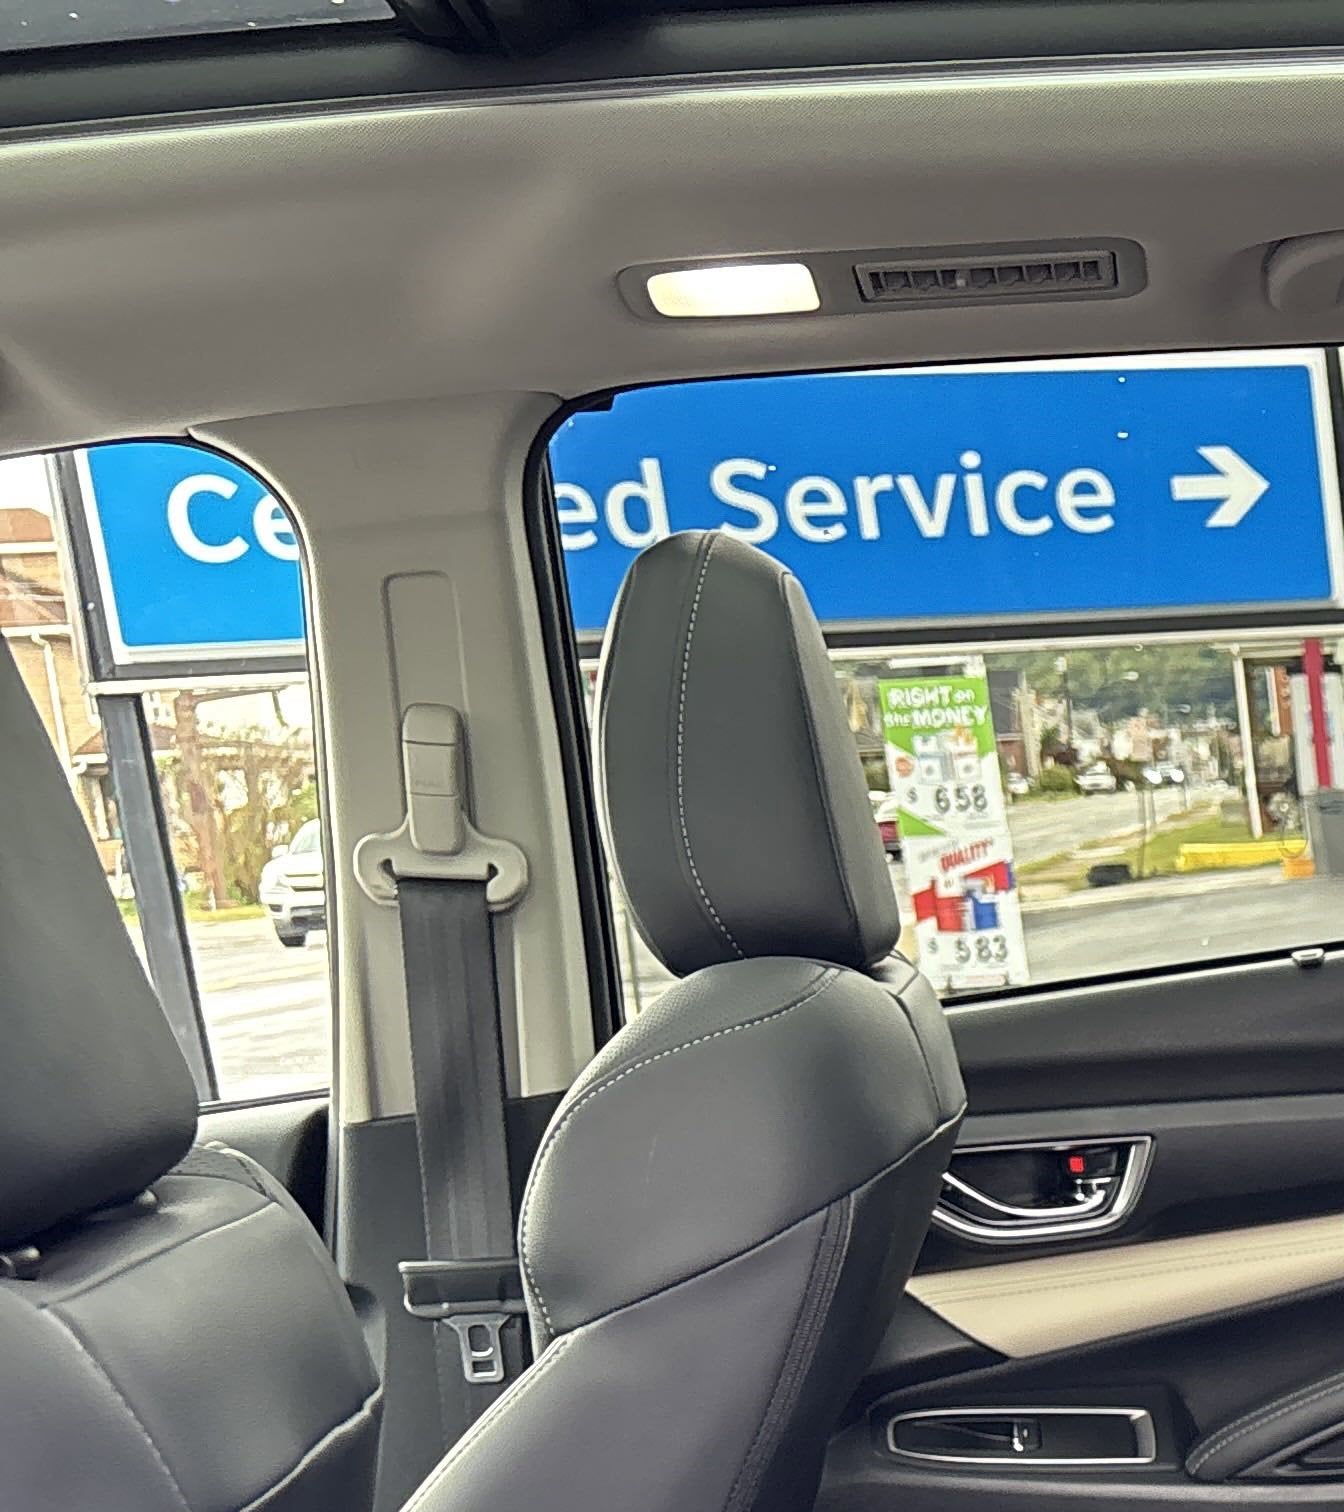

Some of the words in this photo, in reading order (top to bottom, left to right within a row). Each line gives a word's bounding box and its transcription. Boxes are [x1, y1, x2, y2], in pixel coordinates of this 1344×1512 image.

[709, 450, 1116, 545] Service
[887, 684, 952, 709] RIGHT
[911, 704, 988, 729] MONEY
[940, 839, 991, 872] QUALITY
